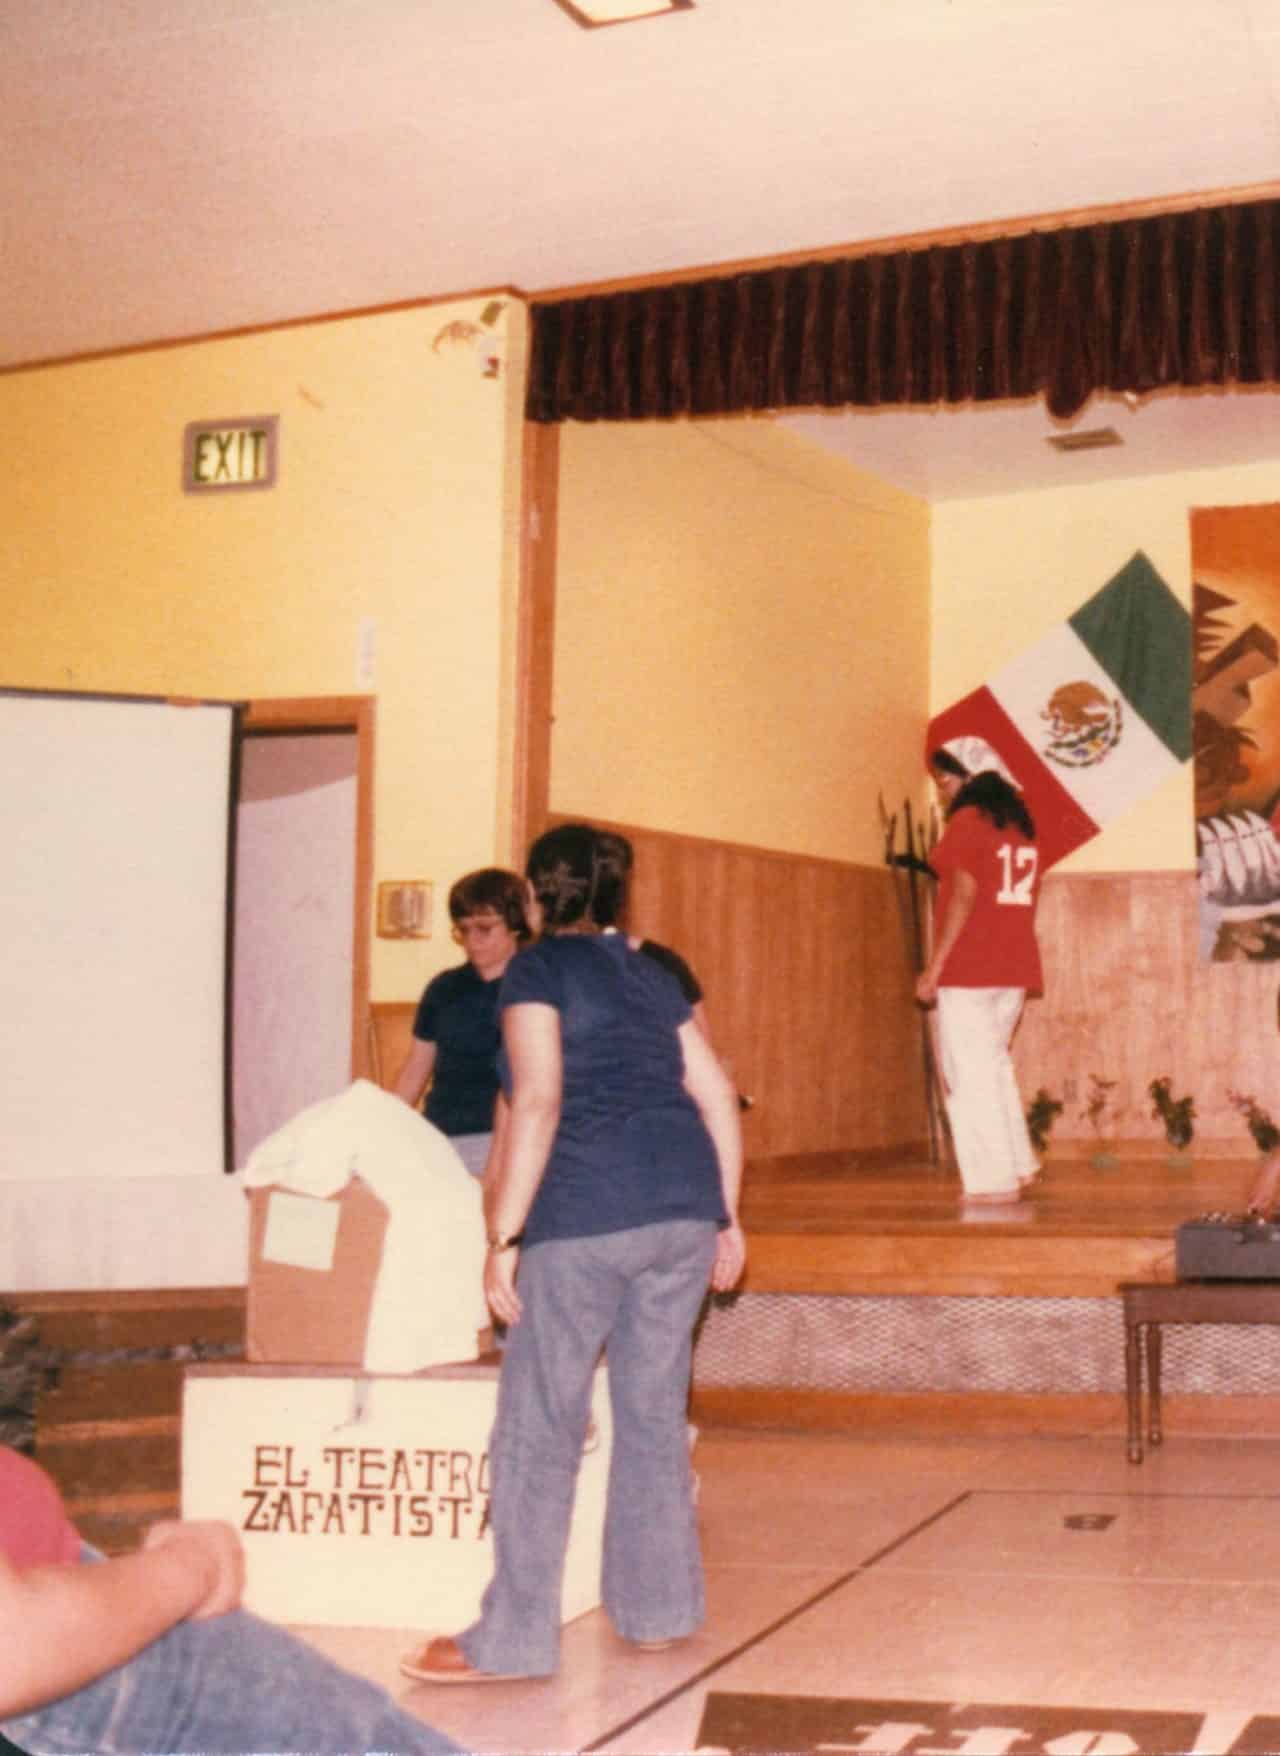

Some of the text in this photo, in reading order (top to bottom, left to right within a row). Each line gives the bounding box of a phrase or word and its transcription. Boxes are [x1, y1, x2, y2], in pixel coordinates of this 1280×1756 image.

[192, 430, 267, 482] EXIT
[996, 844, 1038, 905] 12
[254, 1446, 309, 1486] EL
